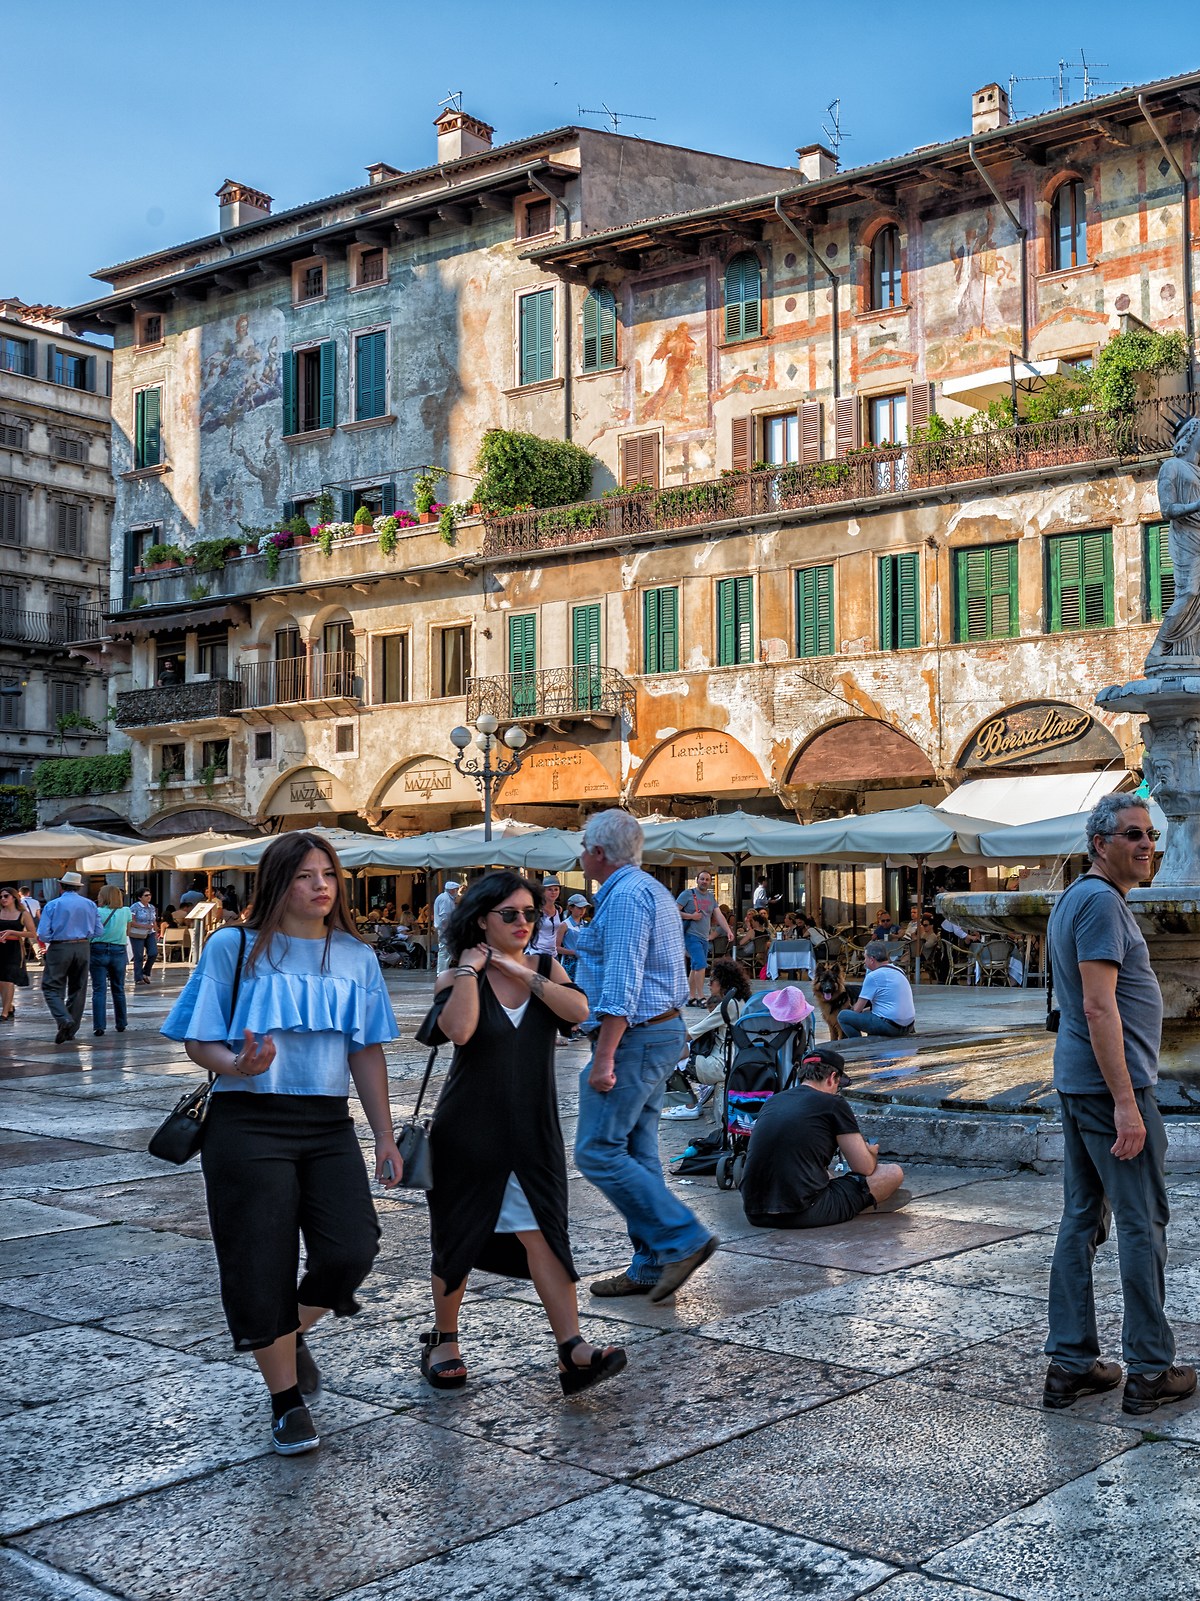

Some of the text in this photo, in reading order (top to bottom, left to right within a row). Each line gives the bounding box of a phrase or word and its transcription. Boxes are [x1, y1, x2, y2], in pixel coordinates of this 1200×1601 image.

[975, 709, 1091, 766] Borsalino
[670, 741, 729, 758] Lamberti
[530, 752, 582, 769] Lamberti
[404, 776, 452, 791] MAZZANTI
